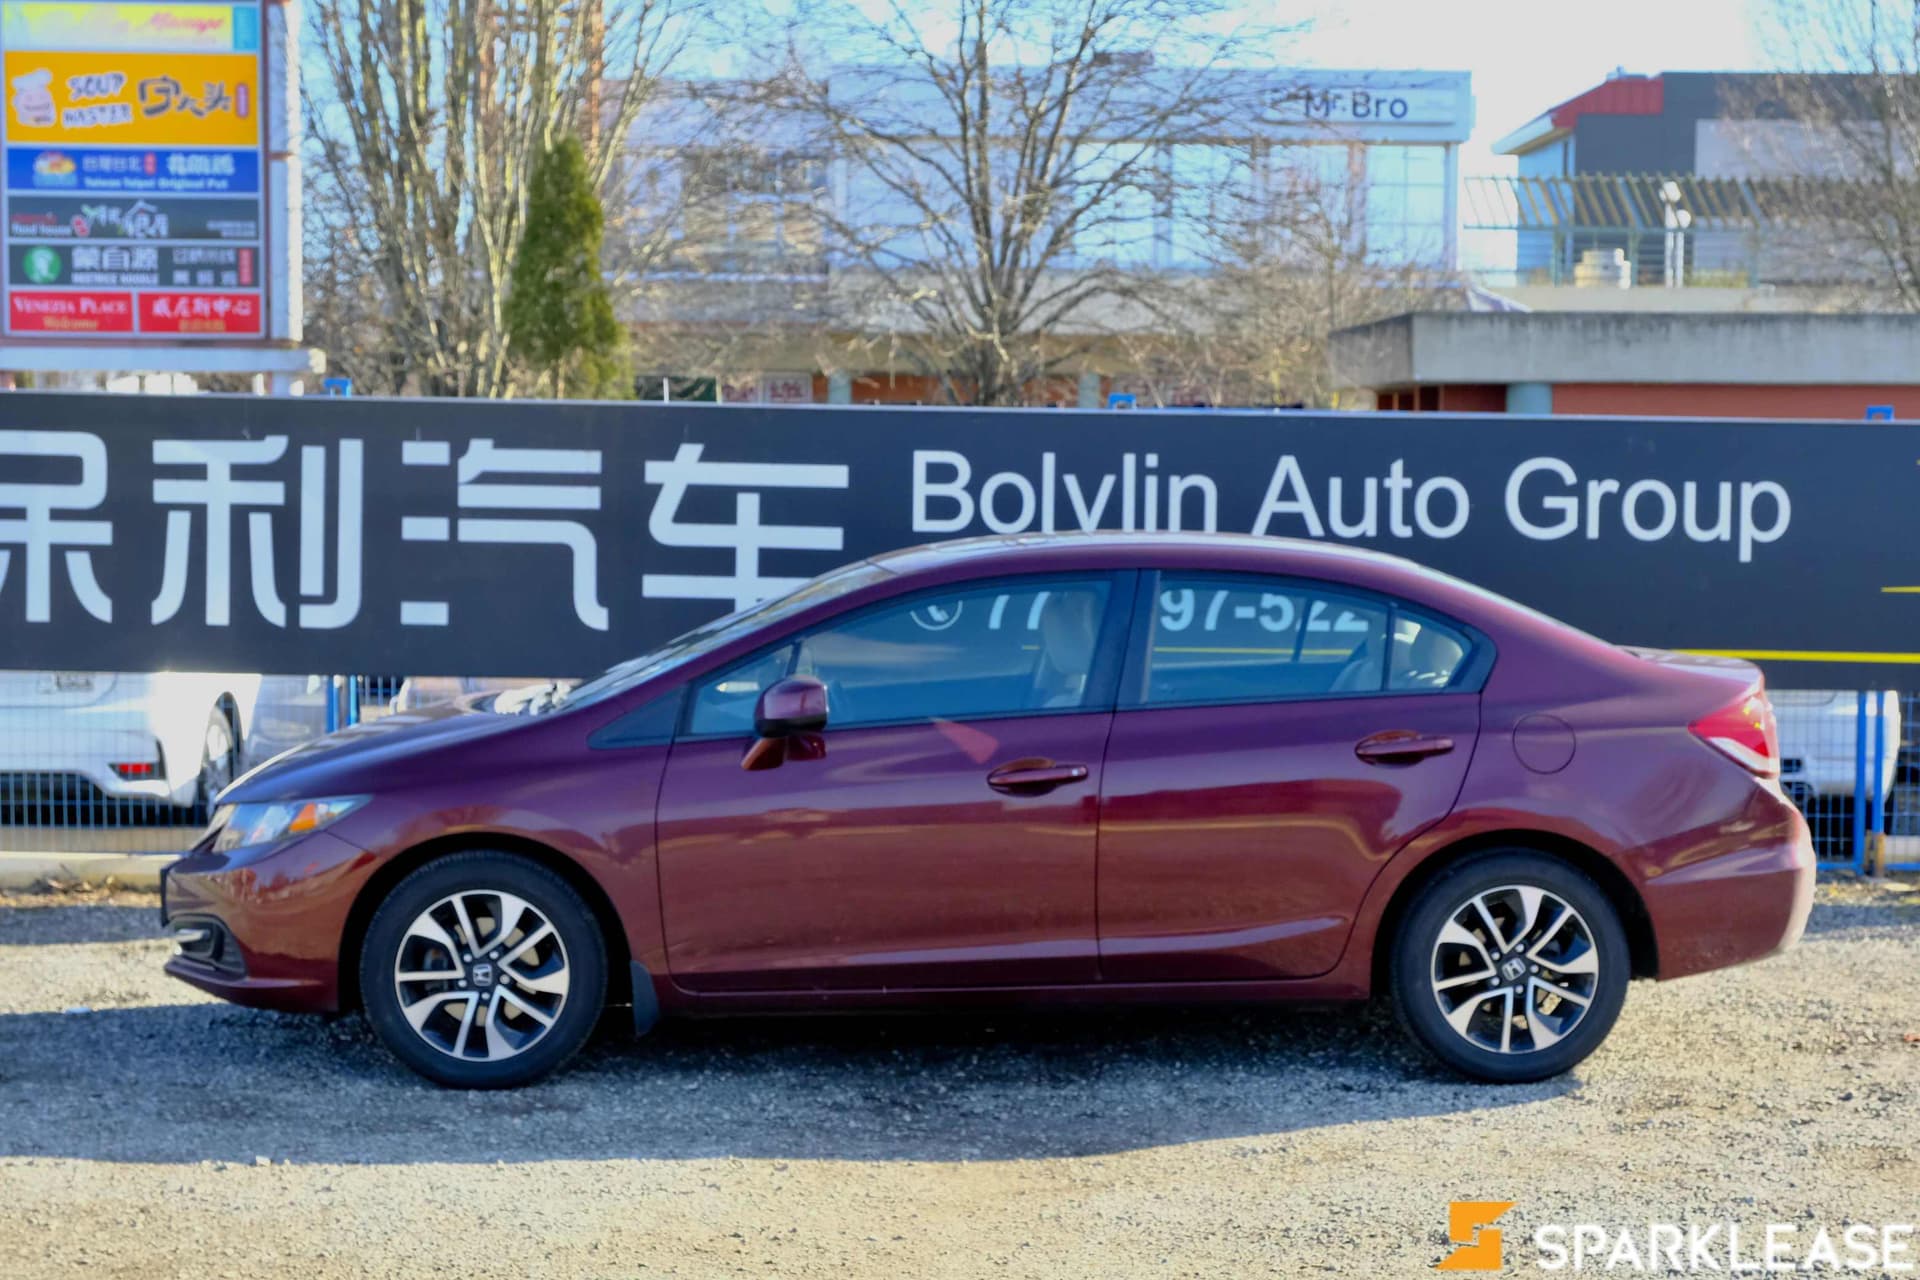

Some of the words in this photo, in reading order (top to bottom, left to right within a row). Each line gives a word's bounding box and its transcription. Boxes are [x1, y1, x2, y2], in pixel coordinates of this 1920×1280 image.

[912, 450, 1218, 533] Bolvlin
[1252, 455, 1470, 539] Auto
[1505, 457, 1792, 563] Group
